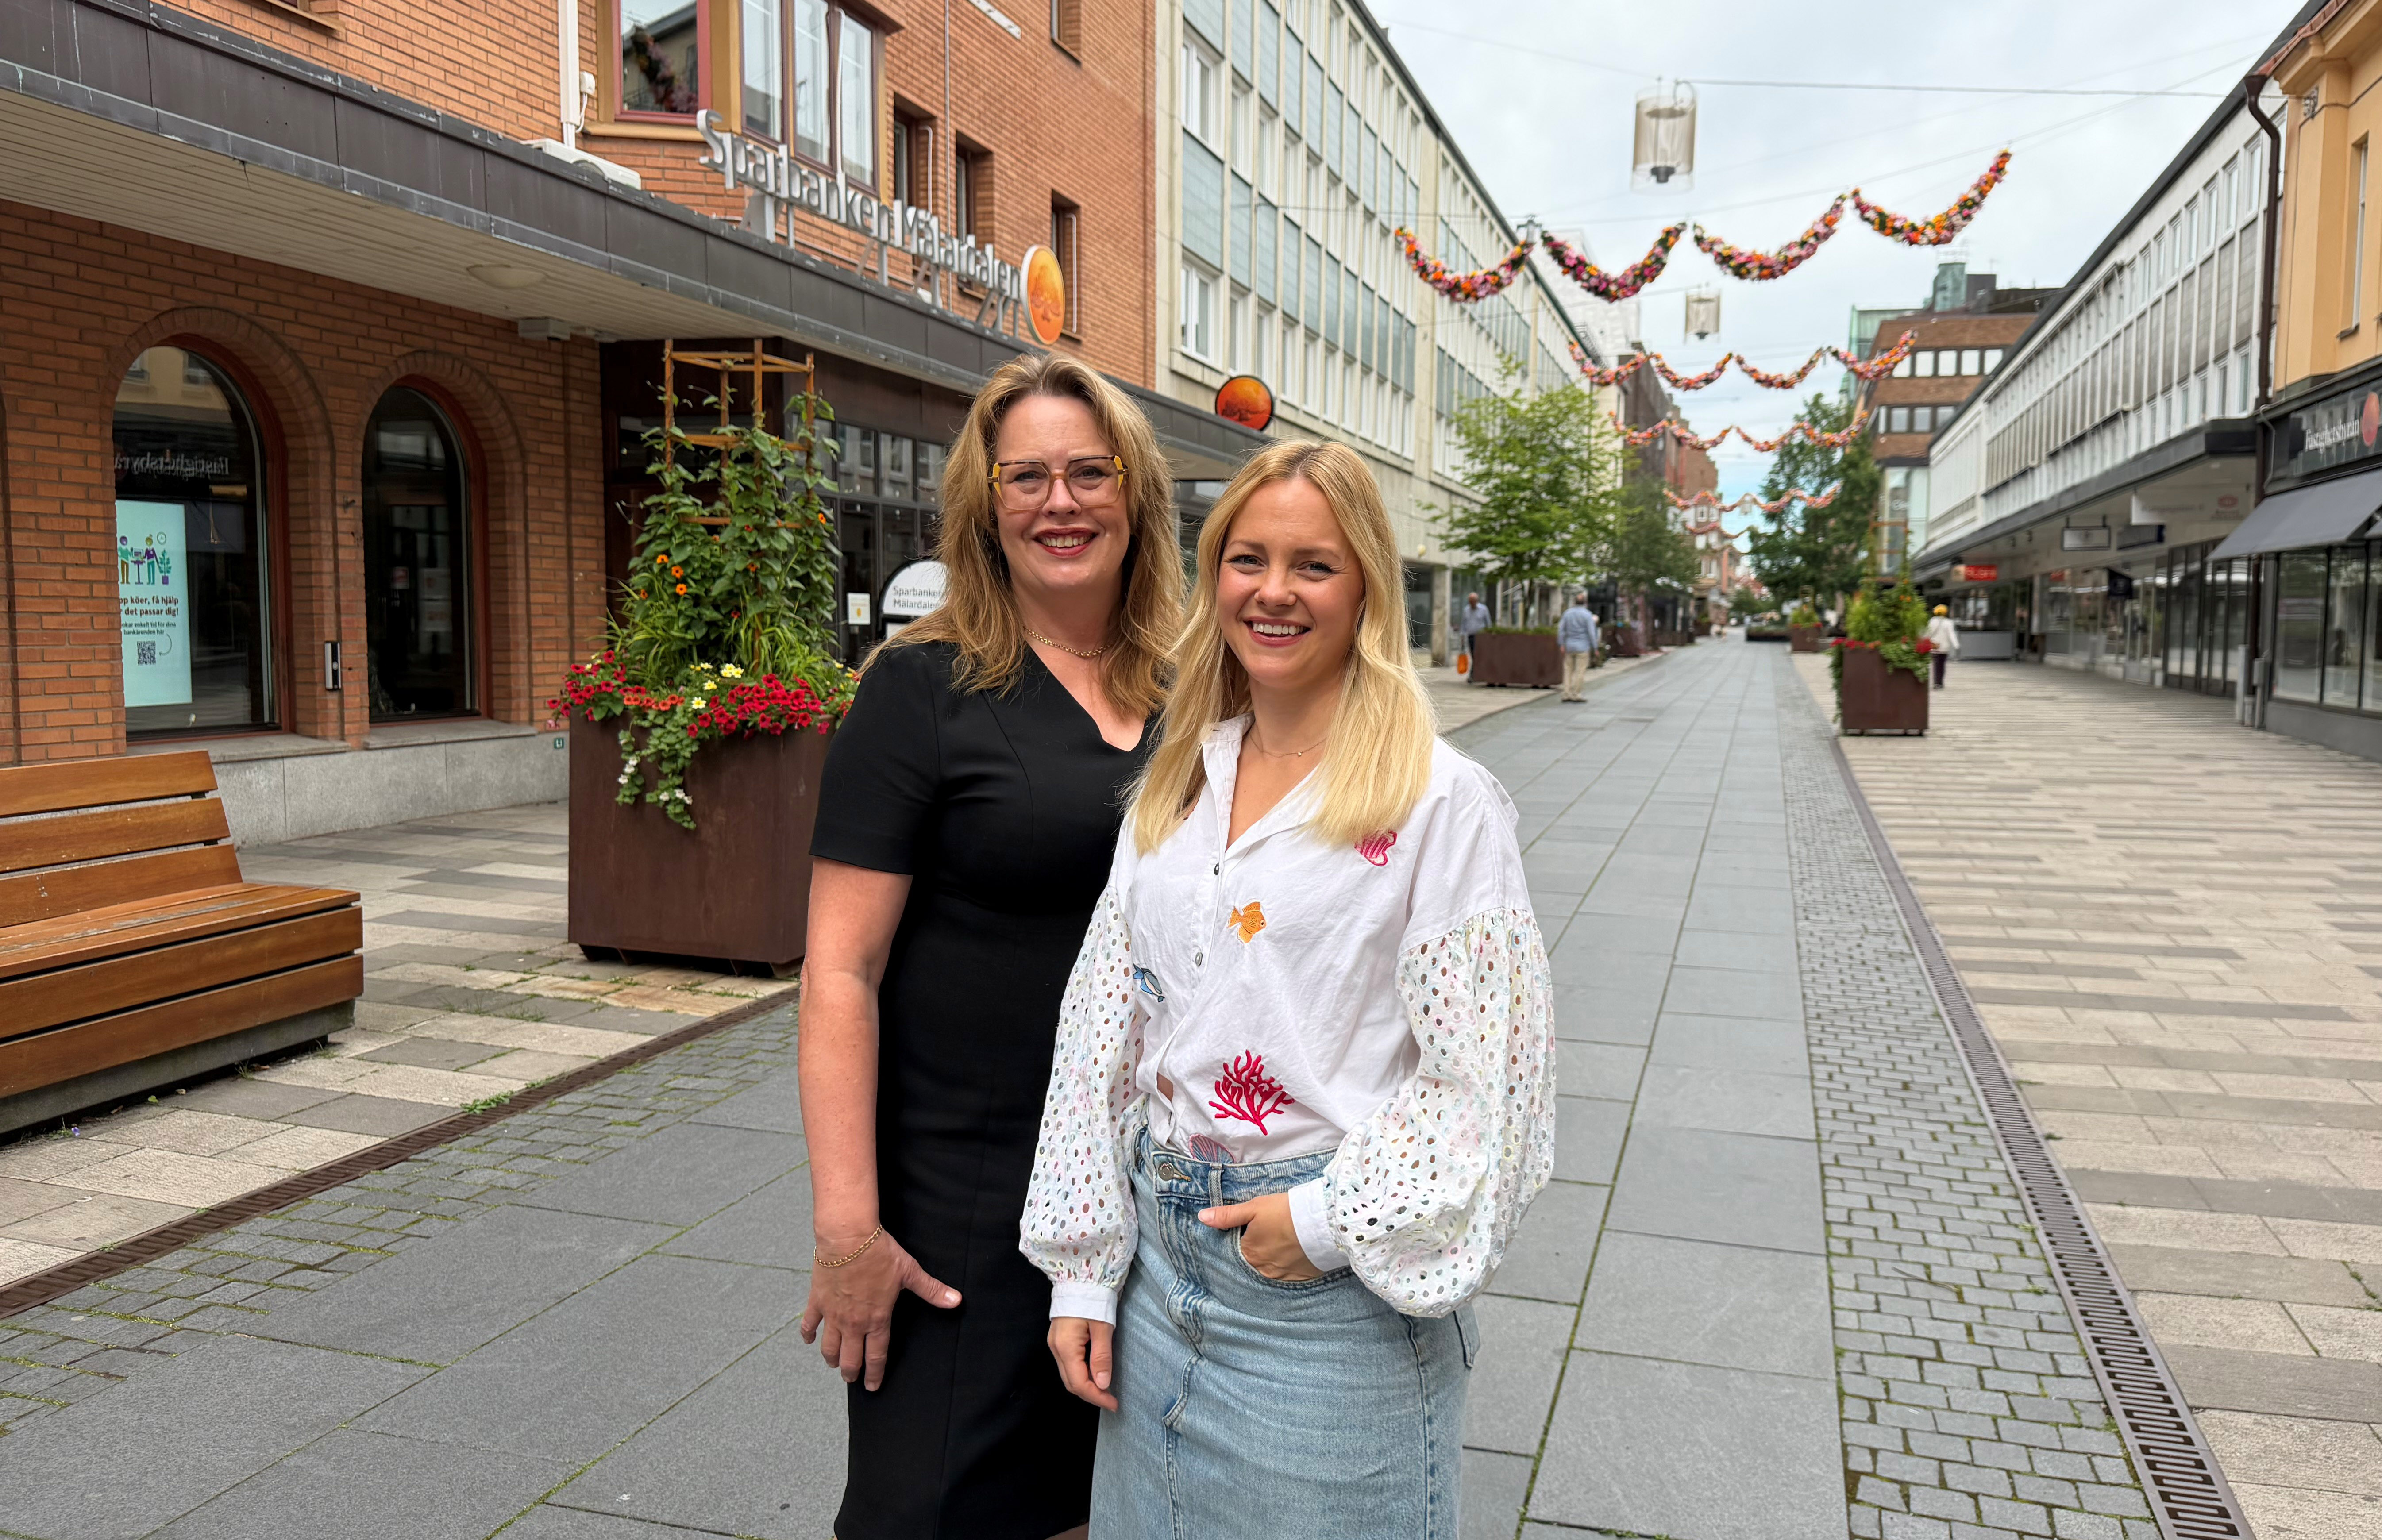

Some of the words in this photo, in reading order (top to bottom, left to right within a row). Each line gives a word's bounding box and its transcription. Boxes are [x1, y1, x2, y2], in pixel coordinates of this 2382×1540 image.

[697, 109, 890, 242] Sparbanken
[893, 199, 1020, 300] Mälardalen
[131, 595, 150, 605] köer,
[152, 595, 159, 604] få
[162, 595, 179, 606] hjälp
[893, 598, 937, 609] Mälardale
[125, 607, 138, 616] det
[140, 609, 163, 618] passar
